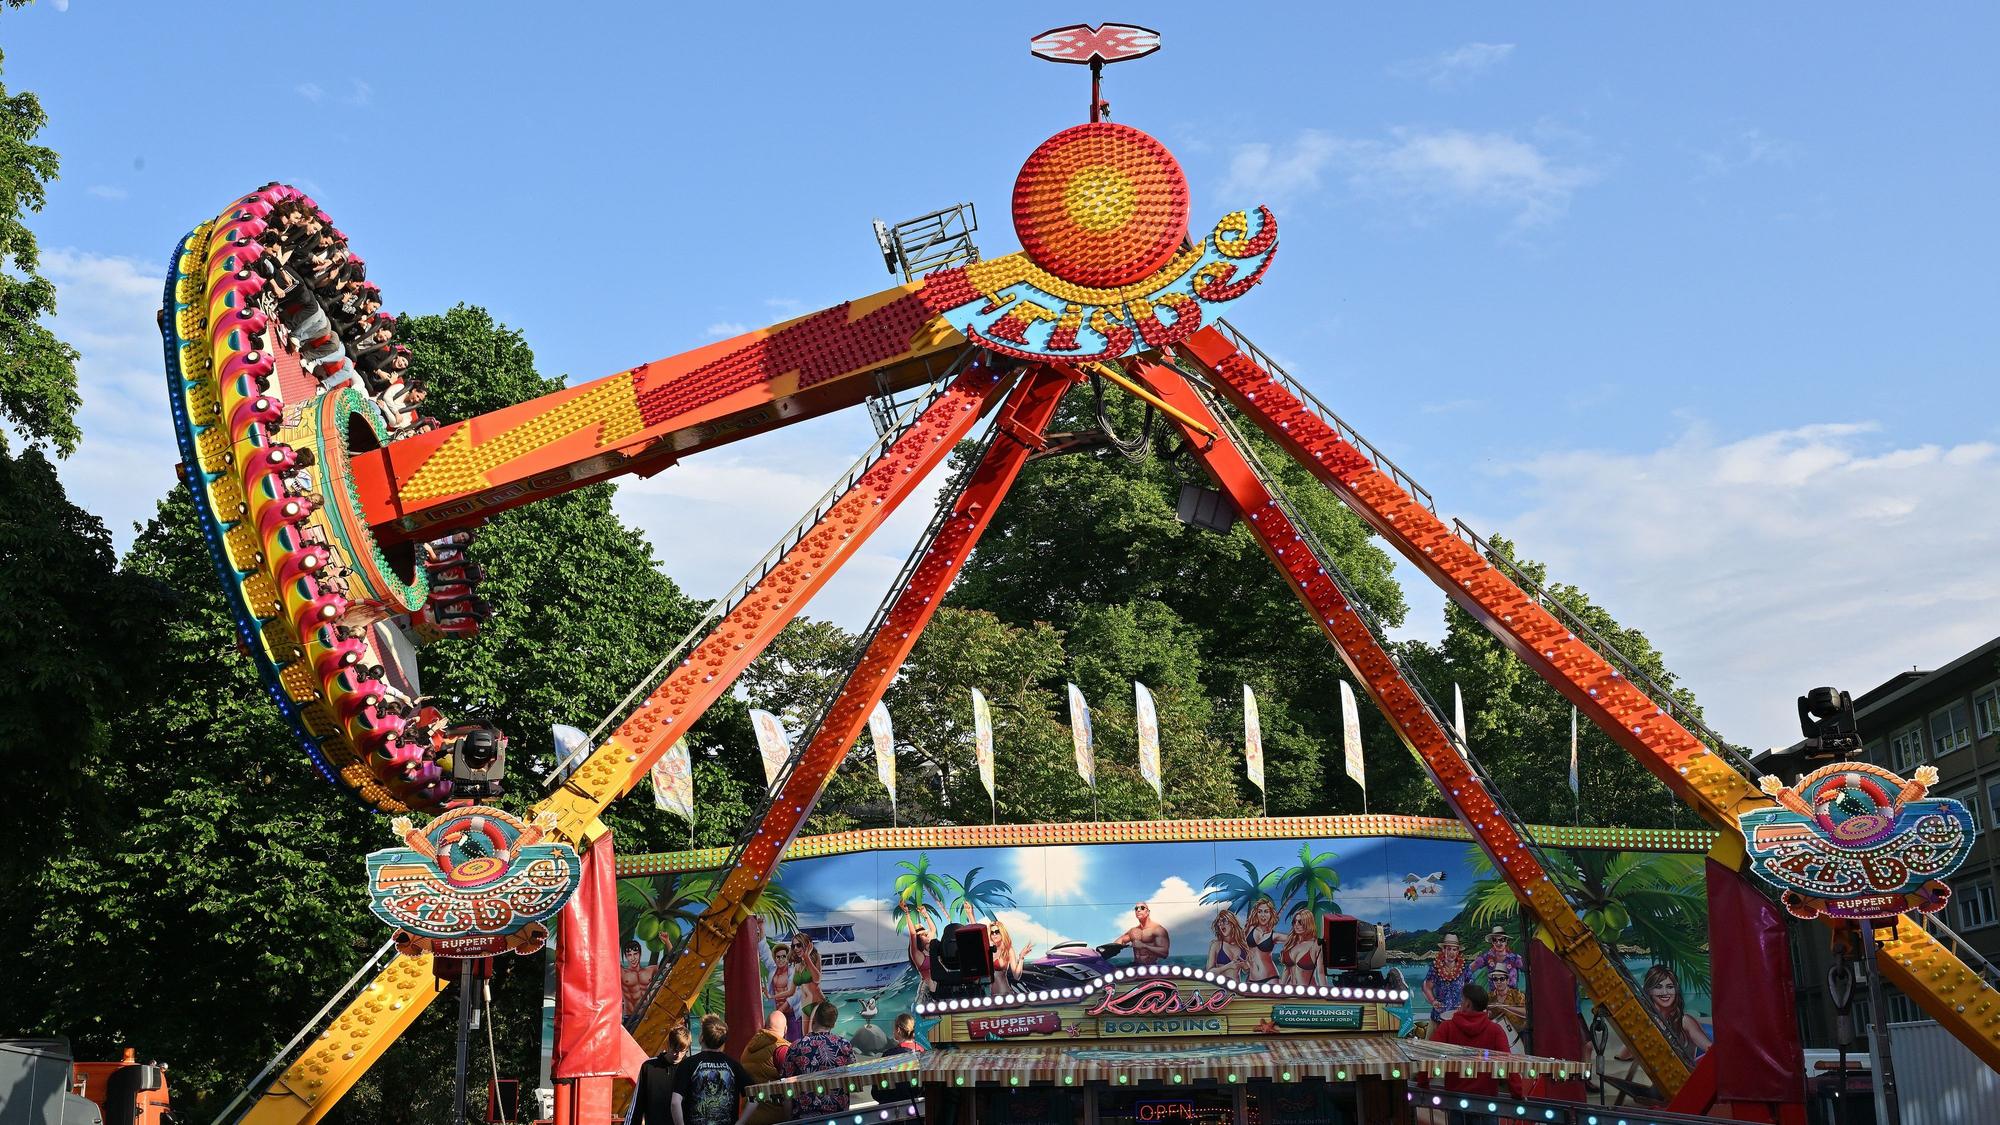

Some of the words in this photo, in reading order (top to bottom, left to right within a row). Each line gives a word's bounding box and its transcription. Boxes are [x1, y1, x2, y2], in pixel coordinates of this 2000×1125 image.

[1836, 896, 1894, 909] RUPPERT
[441, 937, 495, 949] RUPPERT
[1087, 980, 1236, 1016] Kasse
[980, 1015, 1045, 1030] RUPPERT
[1007, 1026, 1029, 1034] Sohn
[1105, 1018, 1221, 1034] BOARDING
[1140, 1104, 1193, 1120] OPEN
